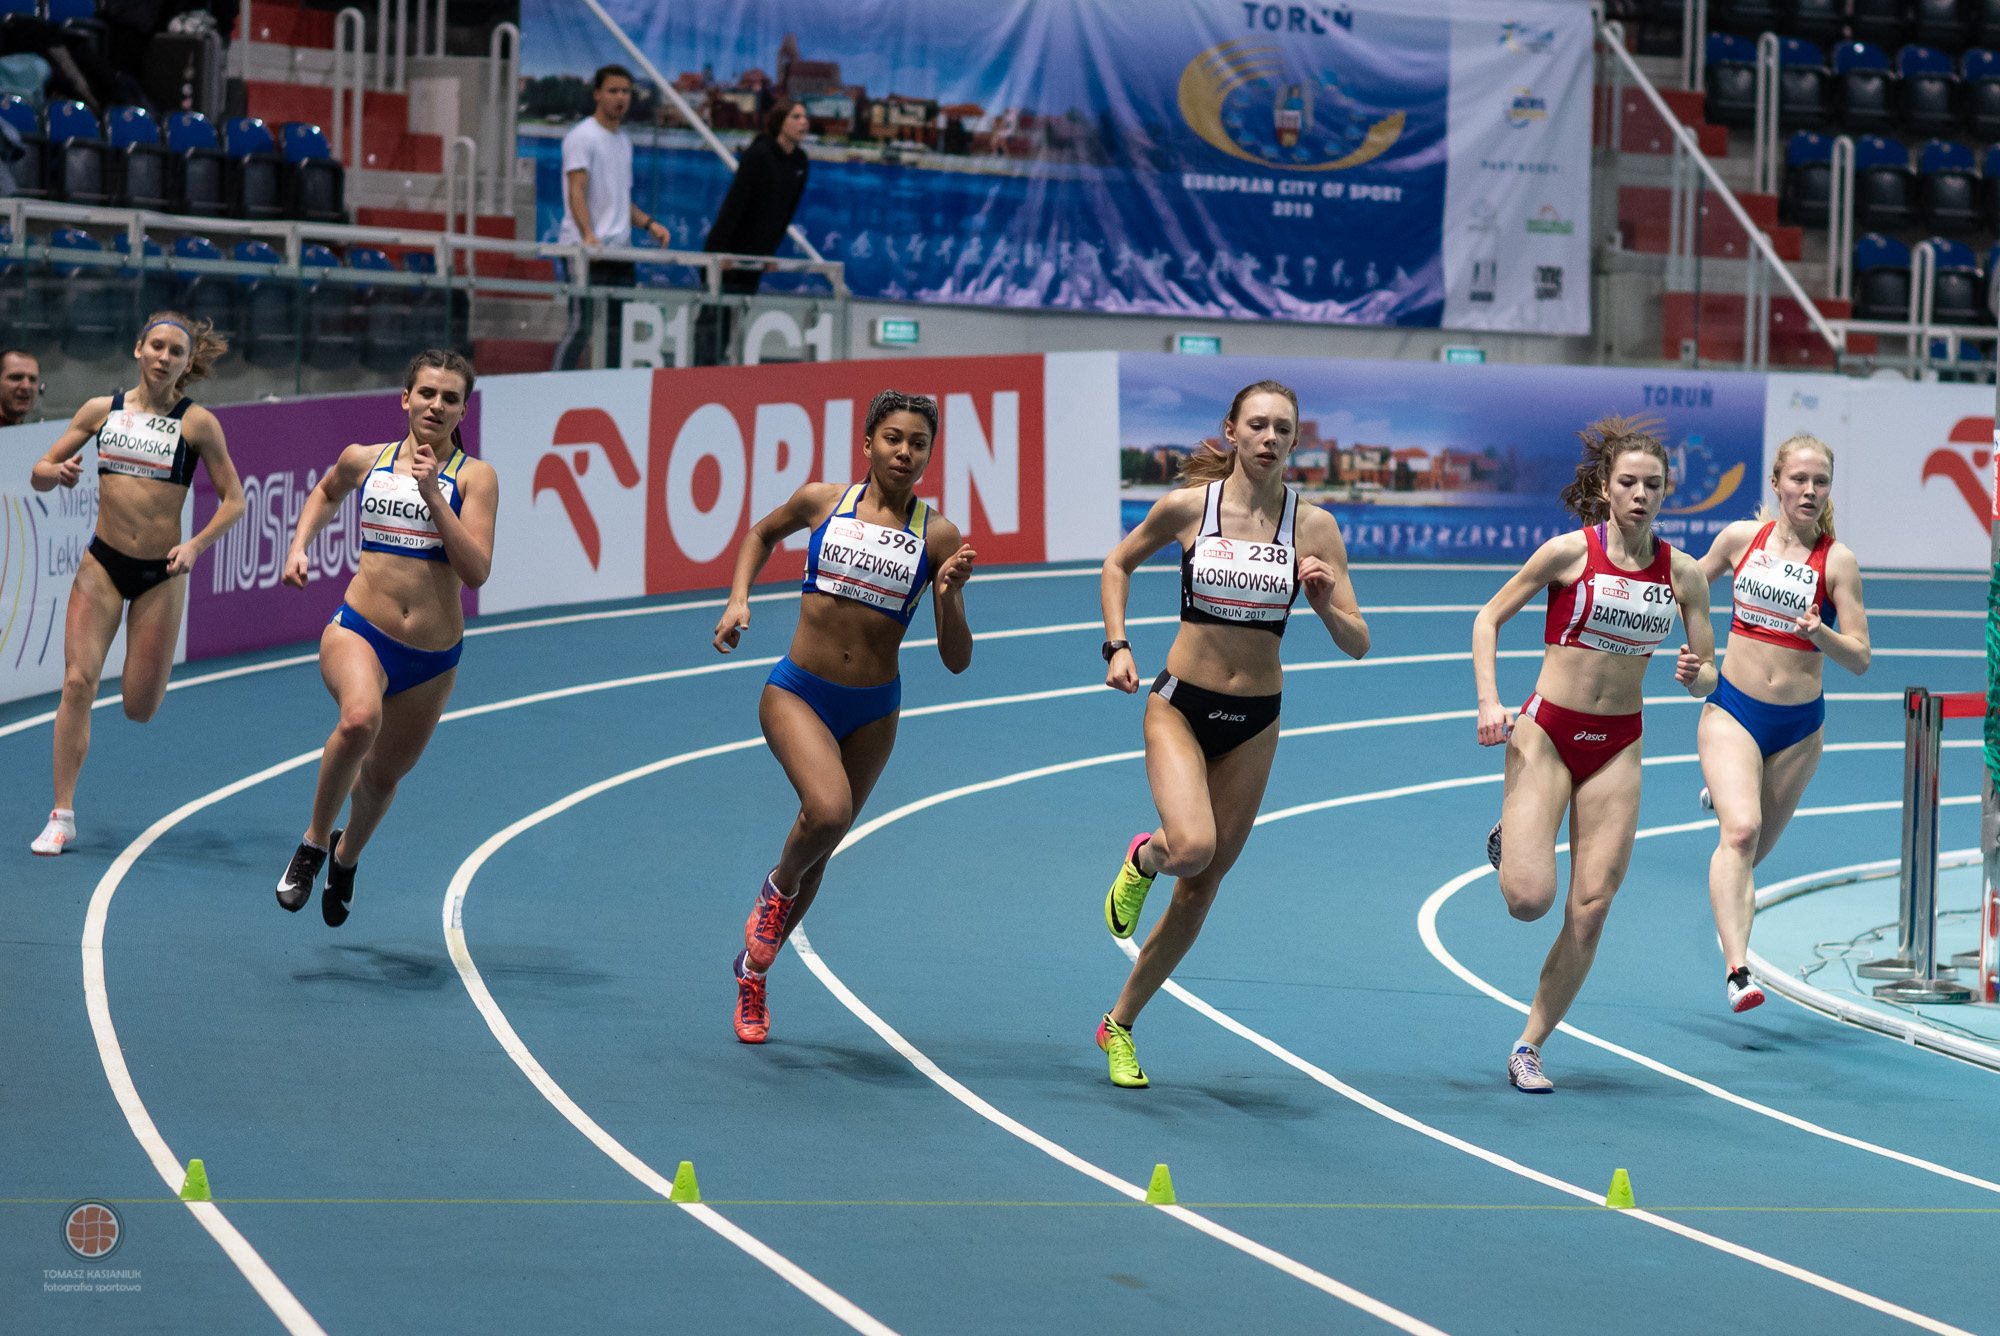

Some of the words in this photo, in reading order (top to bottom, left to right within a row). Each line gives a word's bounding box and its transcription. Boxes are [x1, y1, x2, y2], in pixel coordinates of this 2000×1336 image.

[1182, 173, 1274, 193] EUROPEAN
[1278, 179, 1316, 196] CITY
[1322, 182, 1344, 198] OF
[1349, 184, 1402, 201] SPORT
[146, 417, 177, 434] 426
[101, 432, 171, 457] GADOMSKA
[137, 467, 155, 476] 2019
[666, 391, 1020, 563] ORN
[375, 532, 402, 544] TORUŃ
[403, 537, 425, 547] 2019
[835, 528, 863, 540] ORLEN
[878, 530, 917, 554] 596
[822, 542, 910, 584] KRZYŻEWSKA
[1204, 550, 1233, 559] ORLEN
[1248, 545, 1288, 565] 238
[1196, 568, 1288, 594] KOSIKOWSKA
[1784, 564, 1814, 584] 943
[832, 582, 861, 597] TORUŃ
[863, 591, 885, 604] 2019
[1603, 588, 1629, 599] ORLEN
[1643, 585, 1674, 605] 619
[1209, 605, 1242, 618] TORUŃ
[1245, 610, 1266, 619] 2019
[1592, 605, 1671, 634] BARTNOWSKA
[1741, 610, 1767, 624] TORUŃ
[1769, 619, 1789, 630] 2019
[1598, 639, 1628, 654] TORUŃ
[1629, 646, 1645, 655] 2019
